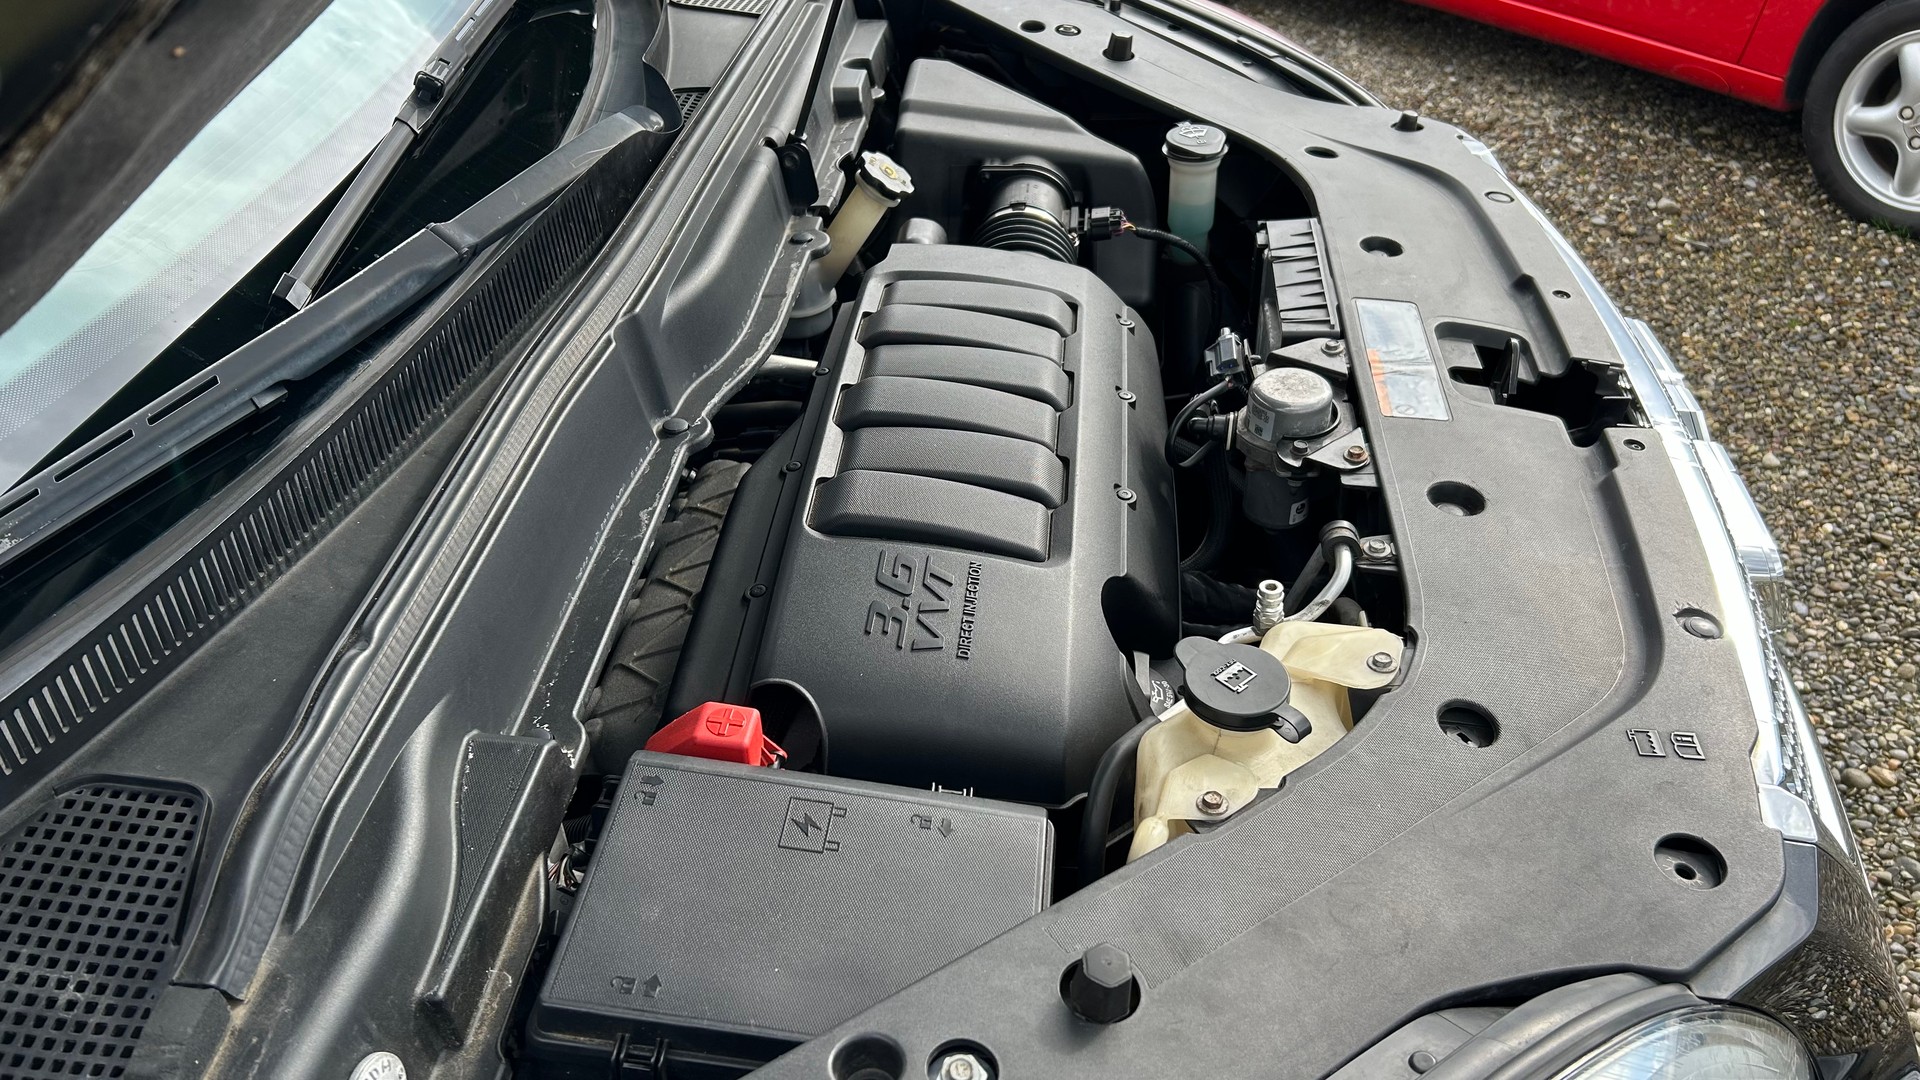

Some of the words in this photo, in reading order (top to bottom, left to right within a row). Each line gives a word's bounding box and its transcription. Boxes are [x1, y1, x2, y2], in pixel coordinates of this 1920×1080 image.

[865, 549, 918, 650] 3.6
[911, 554, 954, 651] VVT
[963, 560, 982, 616] INJECTION
[956, 617, 975, 660] DIRECT
